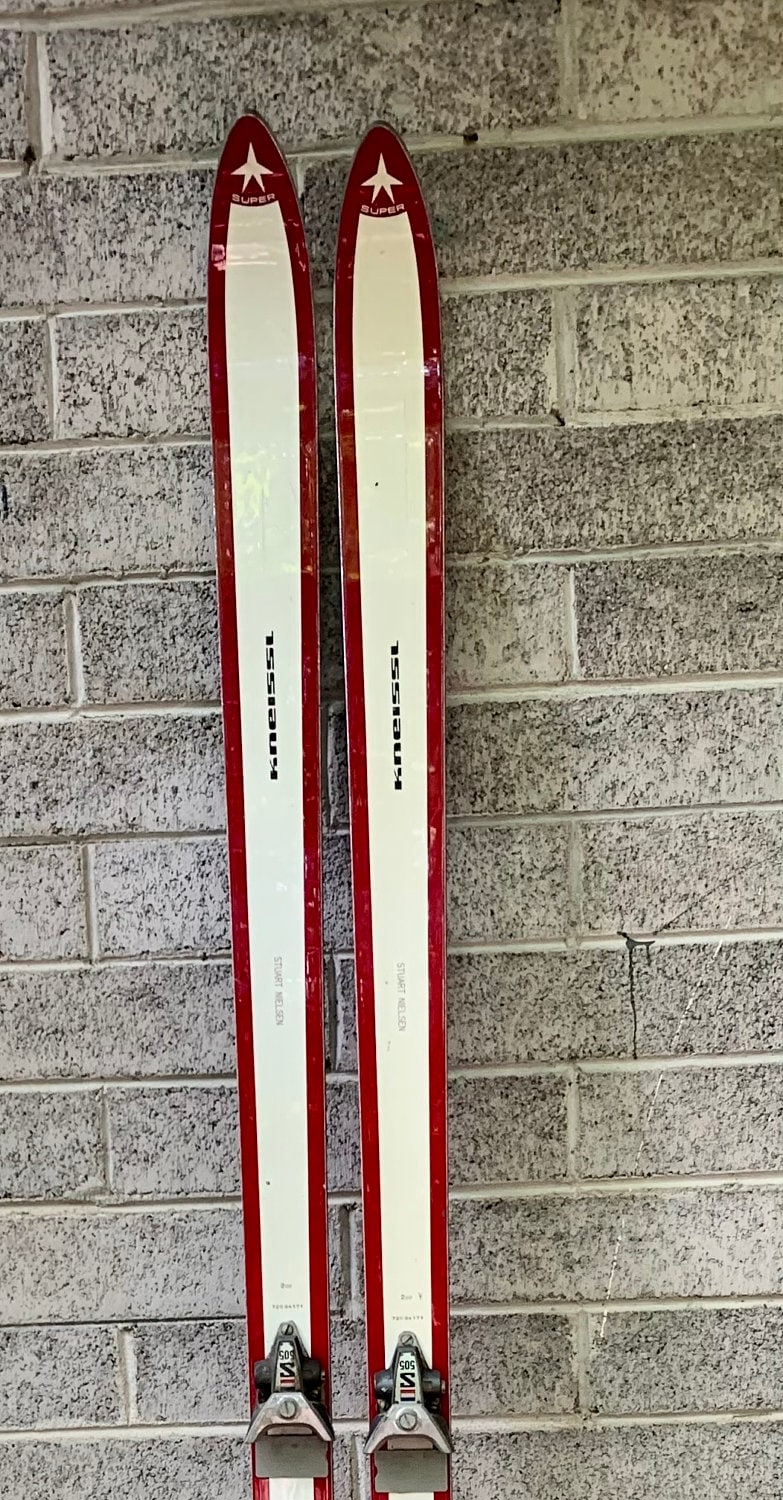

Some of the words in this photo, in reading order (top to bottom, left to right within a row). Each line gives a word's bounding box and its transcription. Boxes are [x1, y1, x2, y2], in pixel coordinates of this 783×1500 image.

[232, 193, 276, 205] SUPER
[360, 203, 405, 215] SUPER
[399, 1360, 415, 1370] 505
